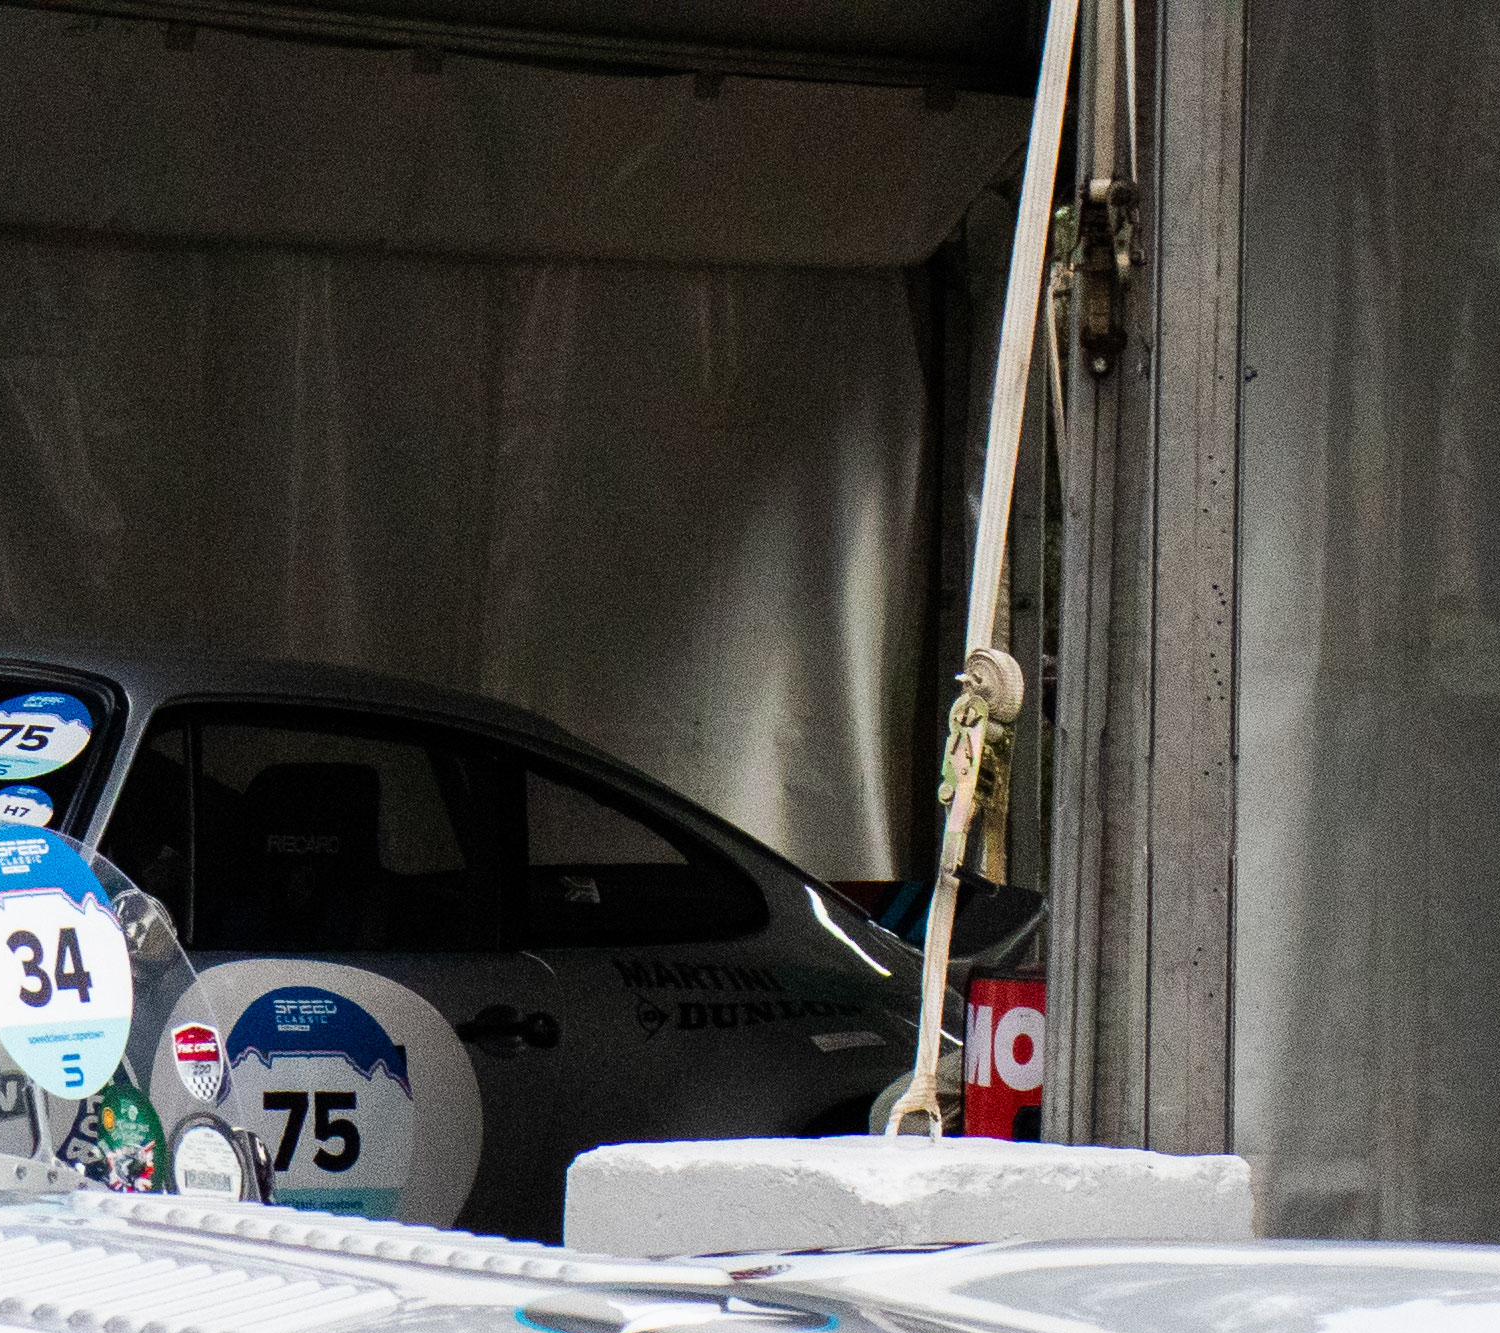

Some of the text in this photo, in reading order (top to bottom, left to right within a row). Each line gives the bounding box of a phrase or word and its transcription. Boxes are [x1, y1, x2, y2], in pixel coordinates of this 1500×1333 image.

[3, 805, 31, 818] H7
[6, 926, 93, 1008] 34
[613, 960, 786, 993] MARTINI
[274, 1000, 337, 1015] SPEED
[262, 1090, 362, 1173] 75
